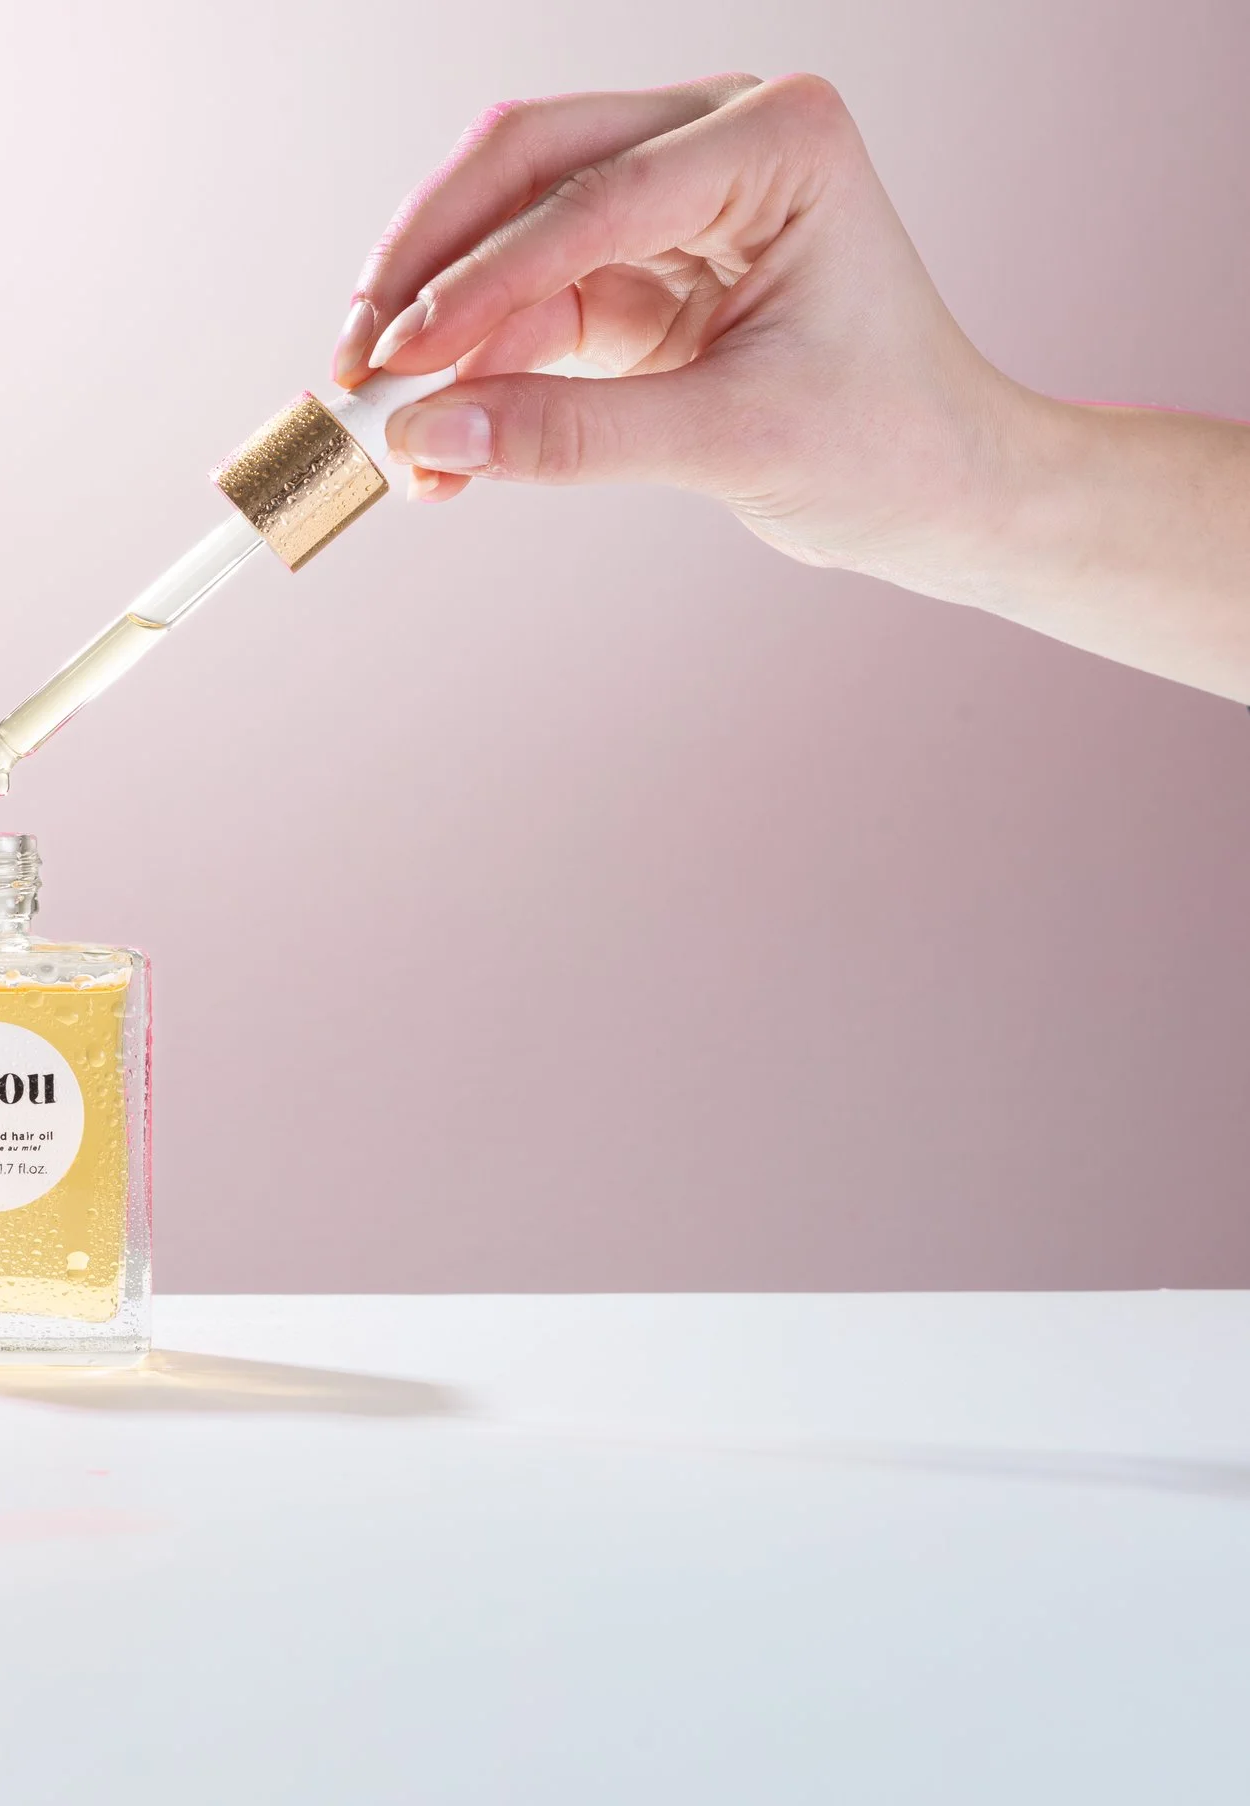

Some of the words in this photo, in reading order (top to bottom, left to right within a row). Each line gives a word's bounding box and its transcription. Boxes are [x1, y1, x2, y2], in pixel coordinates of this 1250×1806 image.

[11, 1132, 34, 1141] hair
[39, 1131, 53, 1141] oil
[0, 1163, 14, 1175] 1.7
[18, 1163, 48, 1175] fl.oz.
